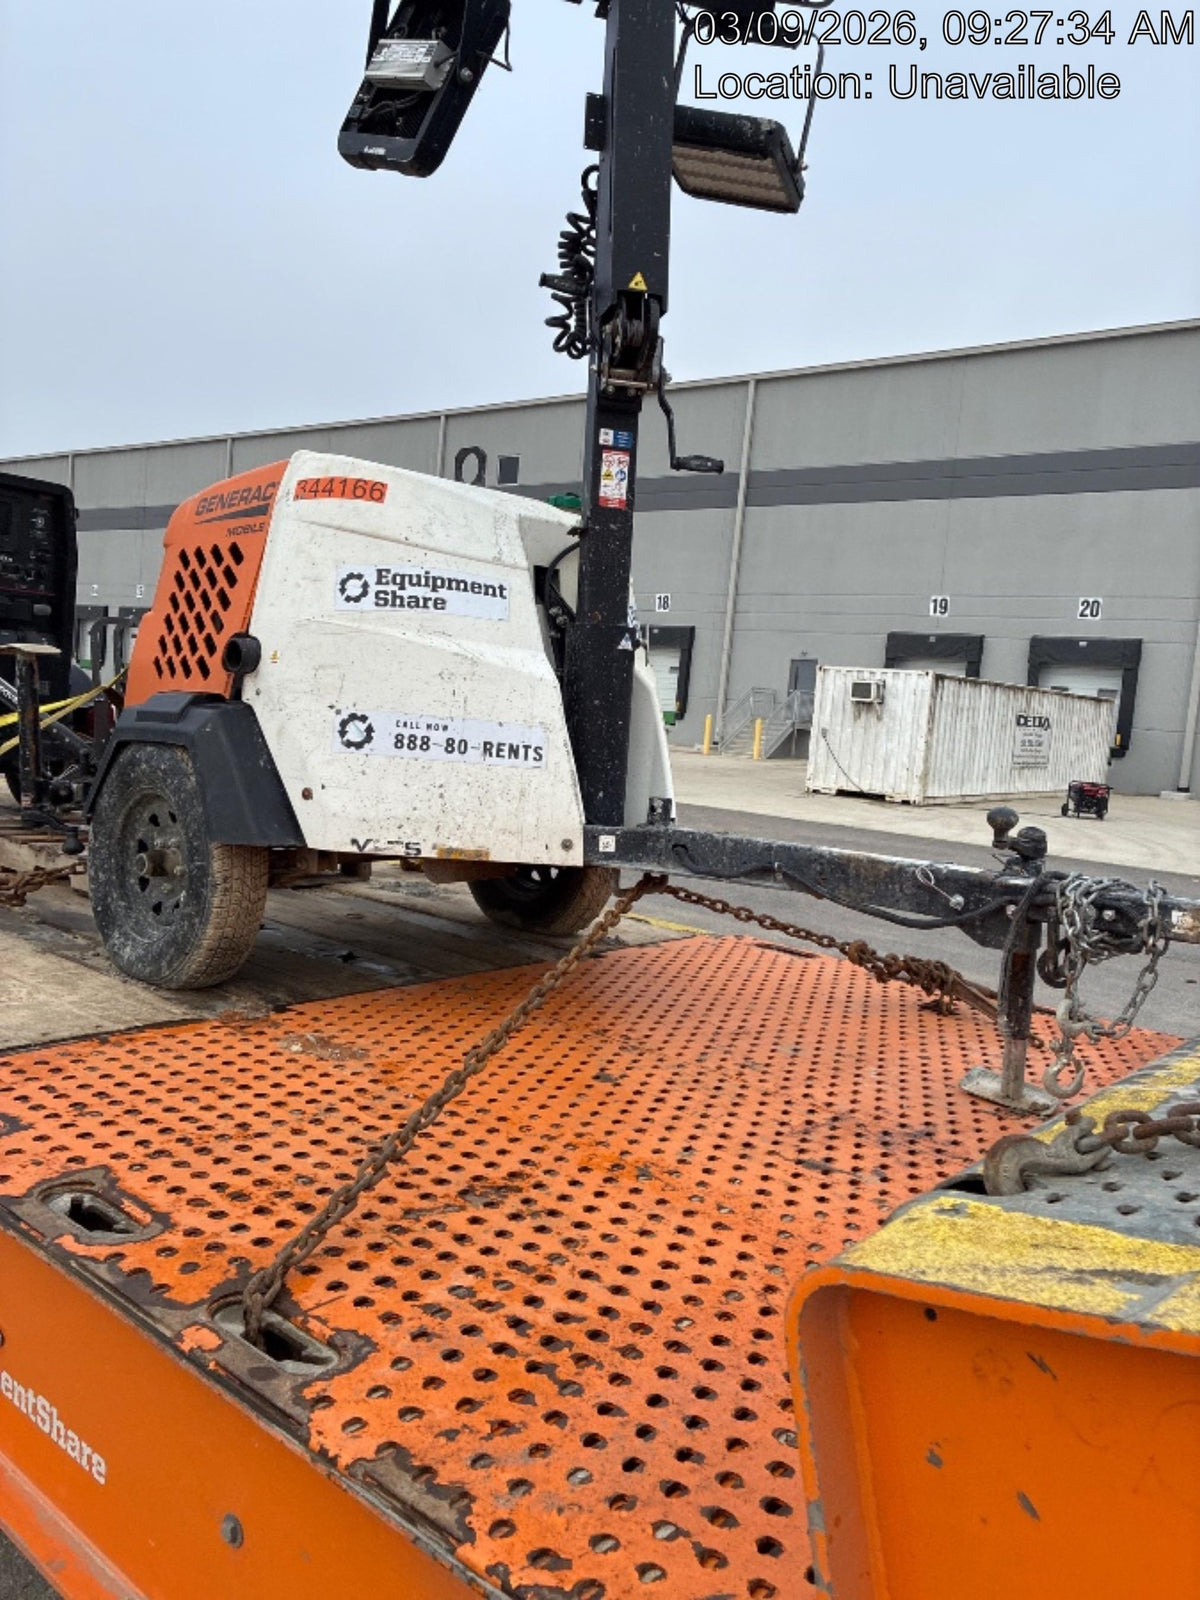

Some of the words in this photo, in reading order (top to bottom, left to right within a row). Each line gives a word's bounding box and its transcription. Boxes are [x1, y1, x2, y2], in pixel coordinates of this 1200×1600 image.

[195, 481, 278, 516] GENERAC
[226, 521, 266, 537] MOBILE
[374, 567, 508, 600] Equipment
[373, 589, 448, 611] Share
[656, 594, 670, 611] 18
[931, 597, 949, 616] 19
[1078, 599, 1101, 618] 20
[395, 719, 421, 730] CALL
[425, 722, 450, 732] NOW
[393, 733, 545, 763] 888-80-RENTS
